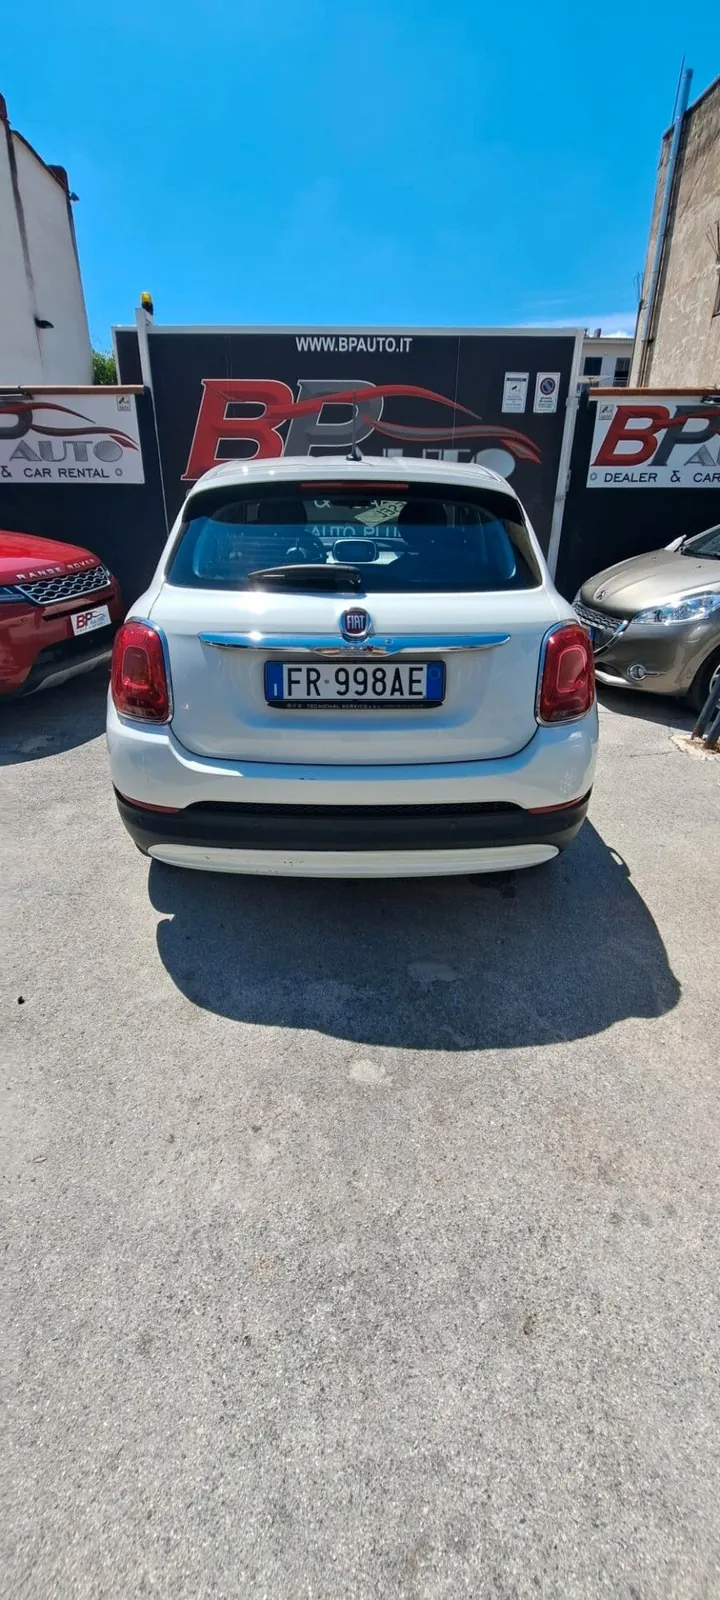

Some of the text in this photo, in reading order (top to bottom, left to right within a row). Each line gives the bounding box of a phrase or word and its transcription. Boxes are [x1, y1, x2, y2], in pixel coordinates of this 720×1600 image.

[295, 336, 413, 352] WWW.BPAUTO.IT
[590, 405, 720, 467] BP
[9, 440, 123, 463] AUTO
[0, 466, 110, 478] & CAR RENTAL
[604, 470, 720, 483] DEALER & CAR
[16, 558, 95, 580] RANGE ROVER
[346, 614, 365, 630] FIAT
[287, 667, 321, 697] FR
[334, 667, 424, 697] 998AE
